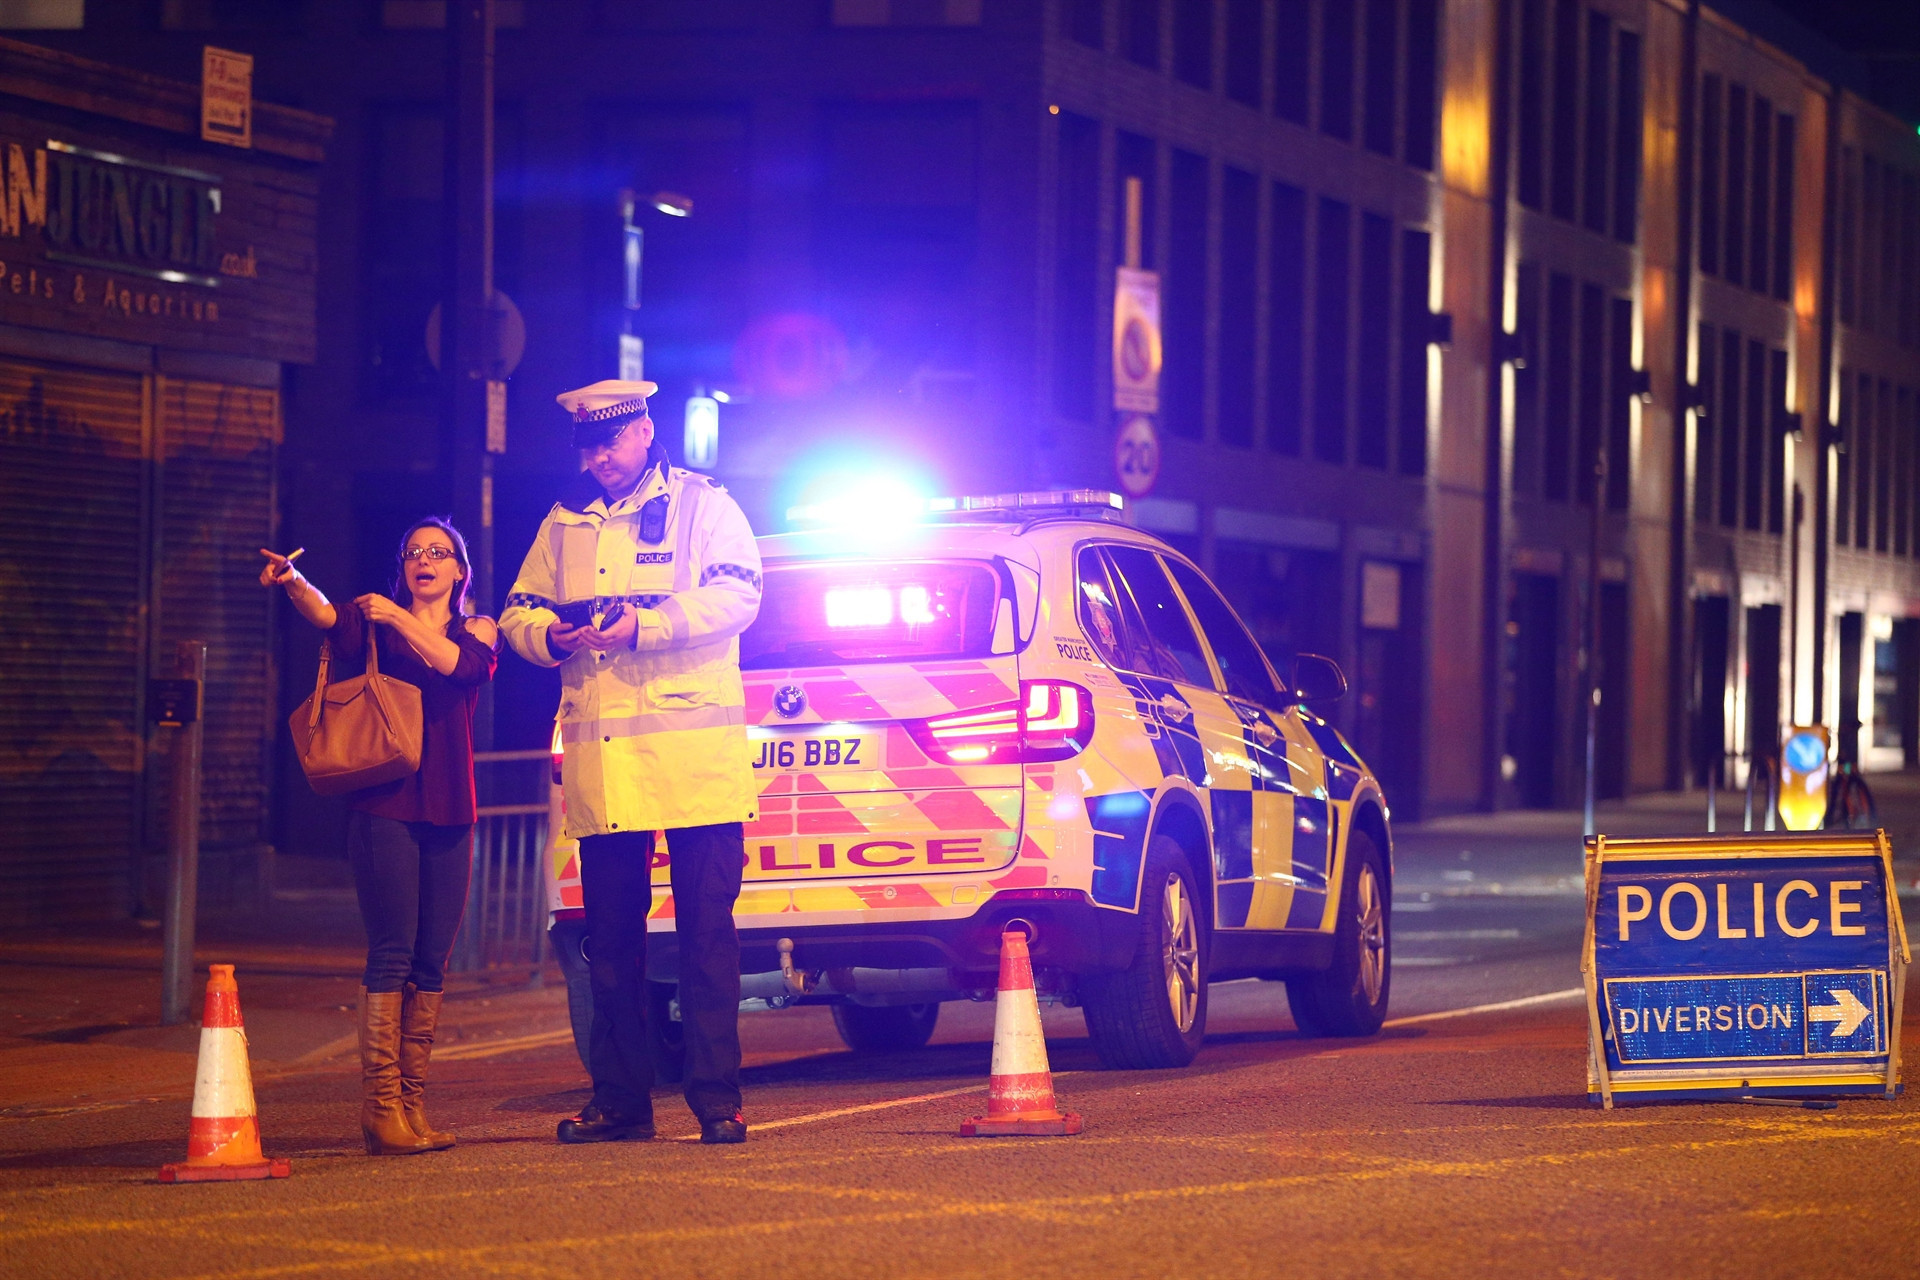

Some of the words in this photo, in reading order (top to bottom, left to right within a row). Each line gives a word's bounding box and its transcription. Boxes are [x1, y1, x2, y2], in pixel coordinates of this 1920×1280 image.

[47, 159, 222, 266] JUNGLE
[74, 274, 86, 304] &
[104, 278, 219, 322] Aquarium
[1123, 439, 1152, 475] 20
[638, 554, 671, 563] POLICE
[1056, 643, 1092, 661] POLICE
[804, 739, 861, 766] BBZ
[650, 838, 985, 870] LICE
[1617, 879, 1867, 941] POLICE
[1619, 1003, 1793, 1034] DIVERSION
